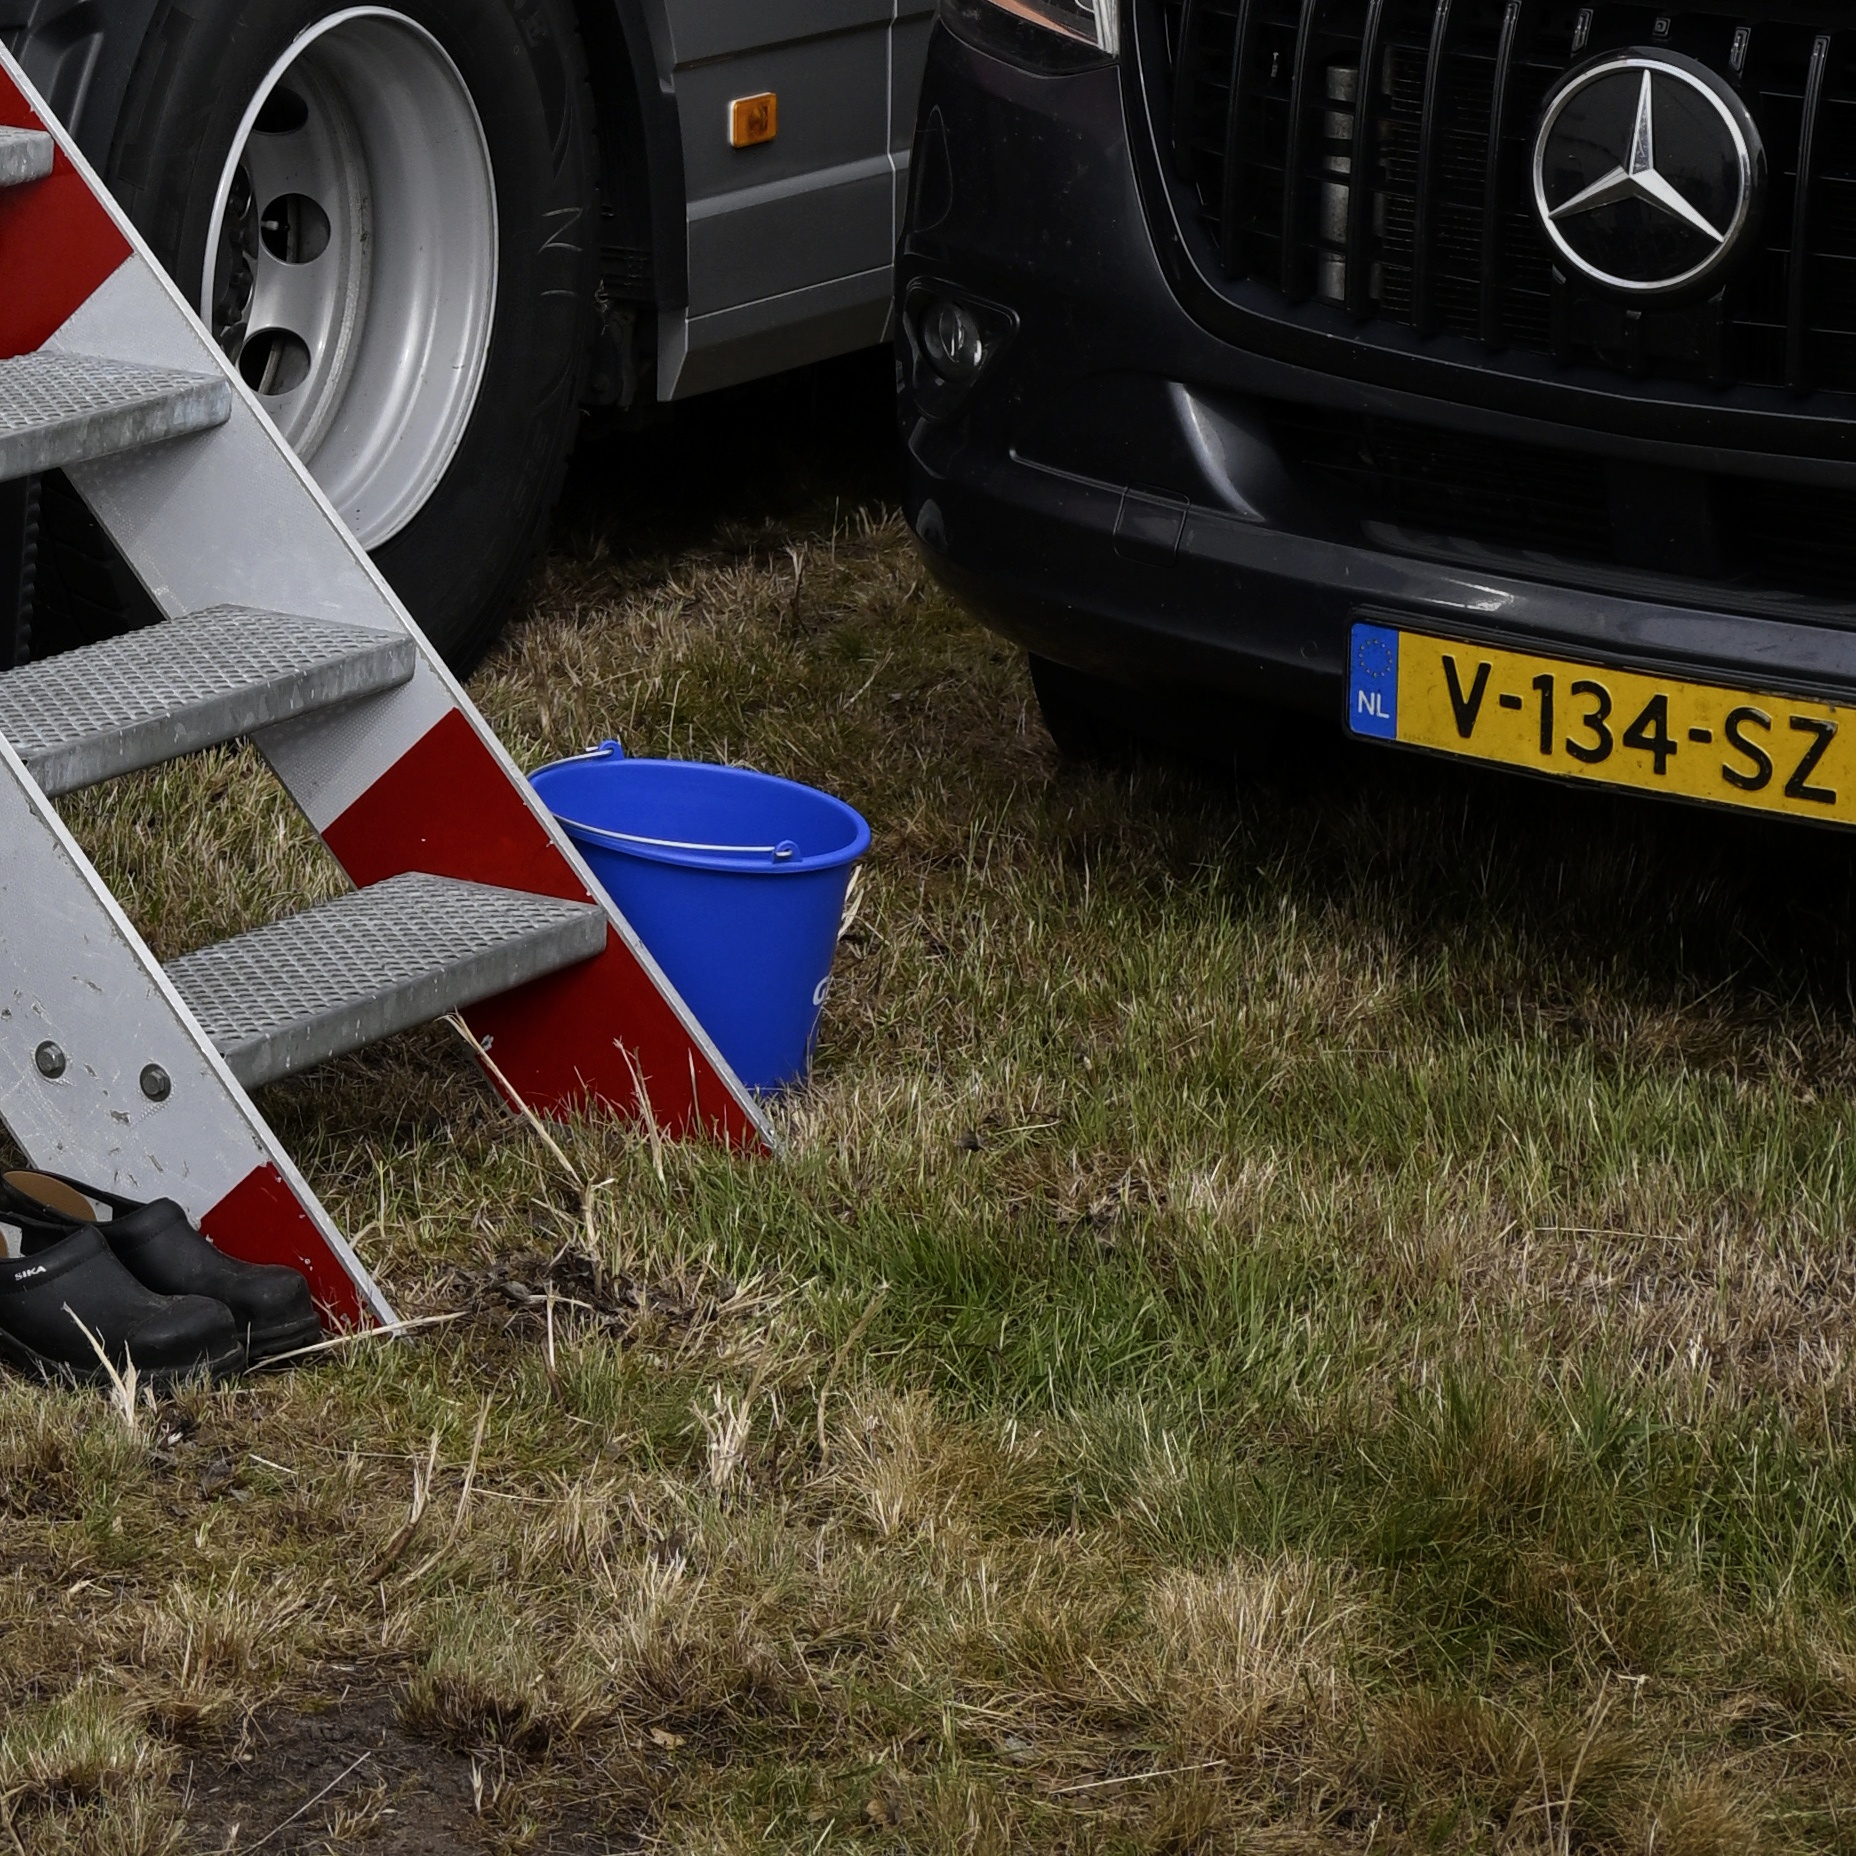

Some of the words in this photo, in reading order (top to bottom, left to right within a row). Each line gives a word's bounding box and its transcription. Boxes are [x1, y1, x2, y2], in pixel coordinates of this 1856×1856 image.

[1357, 689, 1390, 720] NL
[1442, 654, 1839, 805] V-134-SZ
[14, 1265, 47, 1281] SIKA
